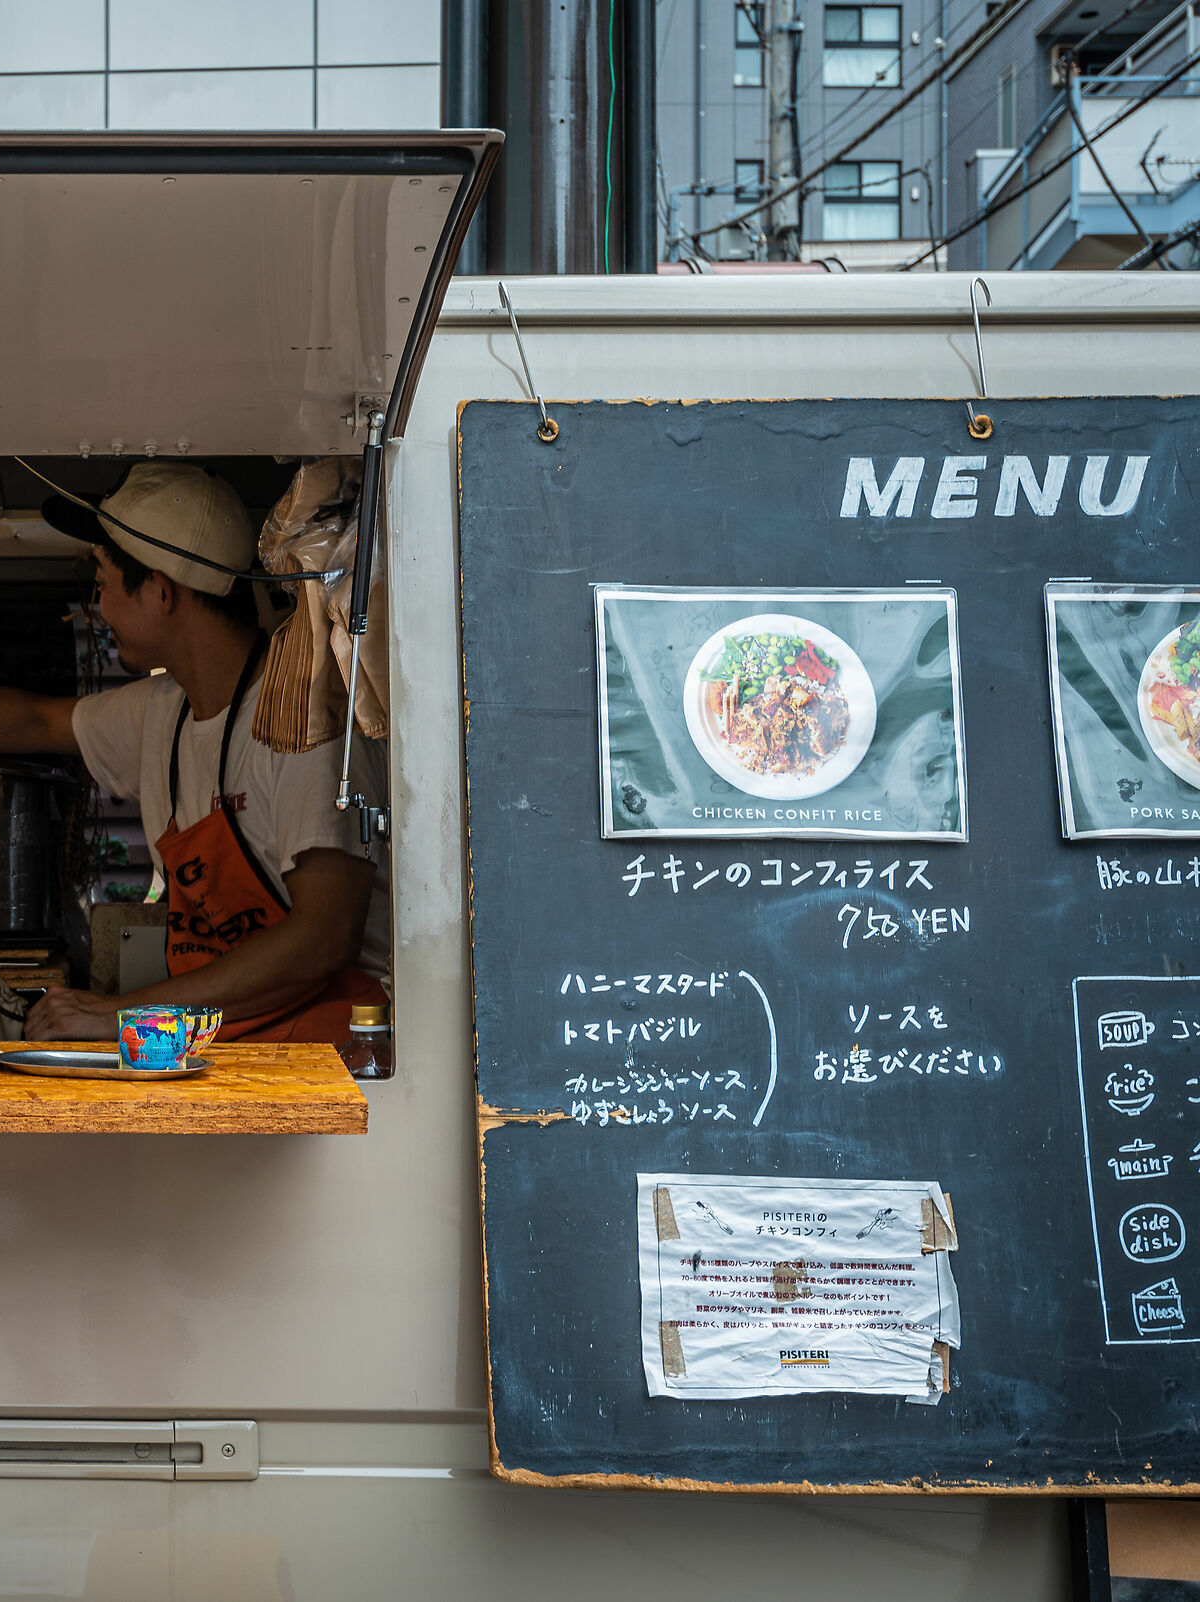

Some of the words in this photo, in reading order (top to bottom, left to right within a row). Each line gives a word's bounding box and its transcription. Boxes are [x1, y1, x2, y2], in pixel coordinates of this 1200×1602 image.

[840, 455, 1150, 518] MENU
[692, 807, 767, 820] CHICKEN
[773, 808, 837, 821] CONFIT
[844, 809, 882, 822] RICE
[1130, 807, 1175, 819] PORK
[622, 853, 934, 897] チキンのコンフィライス
[837, 903, 899, 949] 750
[911, 906, 970, 935] YEN
[560, 971, 729, 997] ハニーマスタード
[564, 1016, 702, 1045] トマトバジル
[848, 1004, 949, 1034] ソースを
[1103, 1021, 1140, 1042] SOUP
[813, 1046, 1002, 1085] お選びください
[1113, 1077, 1146, 1096] rice
[571, 1099, 737, 1127] ゆずこしょうソース
[1120, 1157, 1161, 1176] main
[763, 1211, 828, 1223] PISITERIの
[755, 1225, 837, 1237] チキンコンフィ
[1129, 1231, 1178, 1254] dish
[780, 1350, 829, 1359] PISITERI
